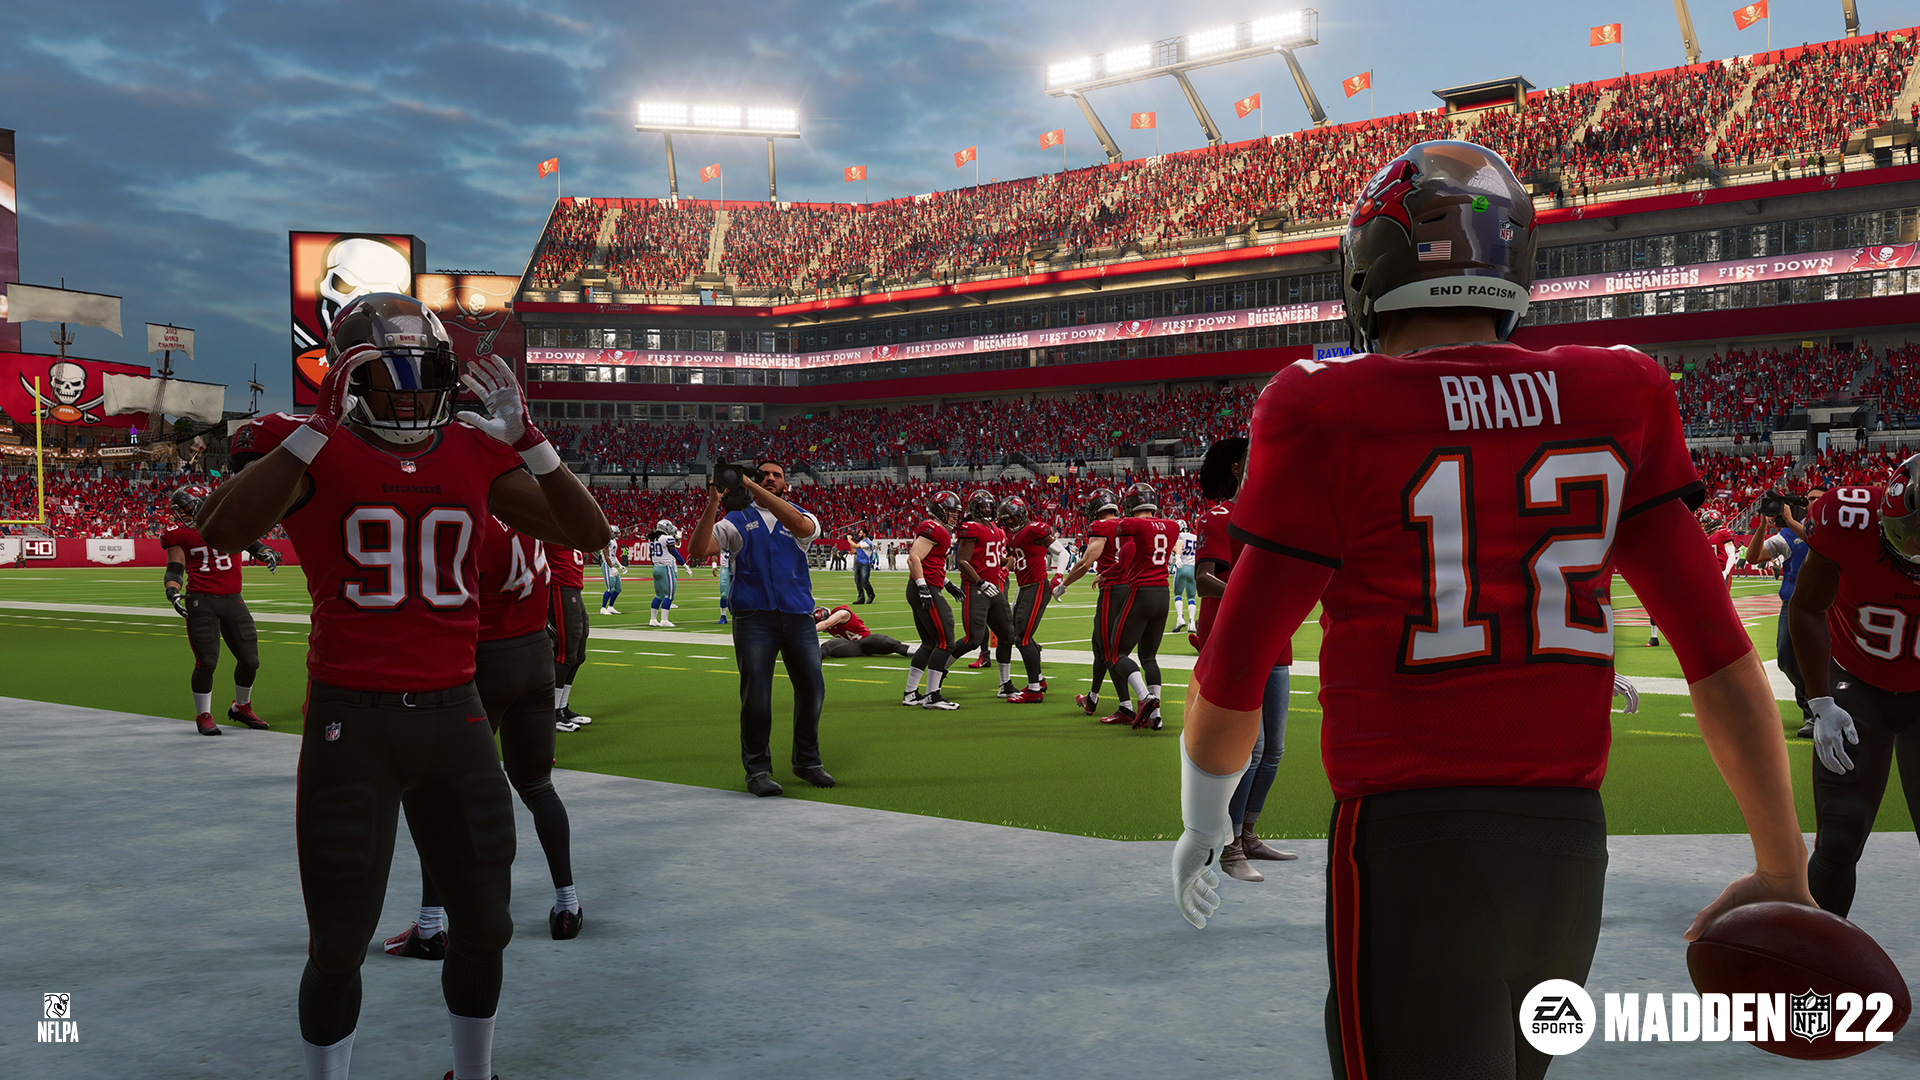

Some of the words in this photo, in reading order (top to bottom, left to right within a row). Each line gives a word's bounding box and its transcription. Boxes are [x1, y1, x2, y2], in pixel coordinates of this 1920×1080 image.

[1617, 269, 1656, 278] TAMPA
[1663, 266, 1685, 274] BAY
[1719, 263, 1768, 279] FIRST
[1774, 257, 1834, 273] DOWN
[1539, 279, 1590, 294] DOWN
[1605, 268, 1699, 293] BUCCANEERS
[1430, 285, 1462, 296] END
[1468, 285, 1516, 299] RACISM
[1247, 306, 1319, 326] BUCCANEERS
[1256, 305, 1287, 313] TAMPA
[1162, 318, 1196, 331] FIRST
[1198, 314, 1237, 327] DOWN
[973, 334, 1029, 351] BUCCANEERS
[1039, 332, 1068, 343] FIRST
[1071, 328, 1106, 339] DOWN
[906, 344, 932, 354] FIRST
[934, 341, 965, 351] DOWN
[545, 351, 586, 360] DOWN
[647, 354, 681, 363] FIRST
[682, 355, 724, 363] DOWN
[735, 356, 800, 368] BUCCANEERS
[807, 354, 832, 364] FIRST
[833, 351, 861, 361] DOWN
[1440, 370, 1561, 431] BRADY
[381, 483, 442, 495] BUCCANEERS
[25, 541, 53, 555] 40
[1152, 533, 1168, 566] 8
[1395, 435, 1634, 674] 12
[189, 545, 233, 572] 78
[340, 502, 476, 612] 90
